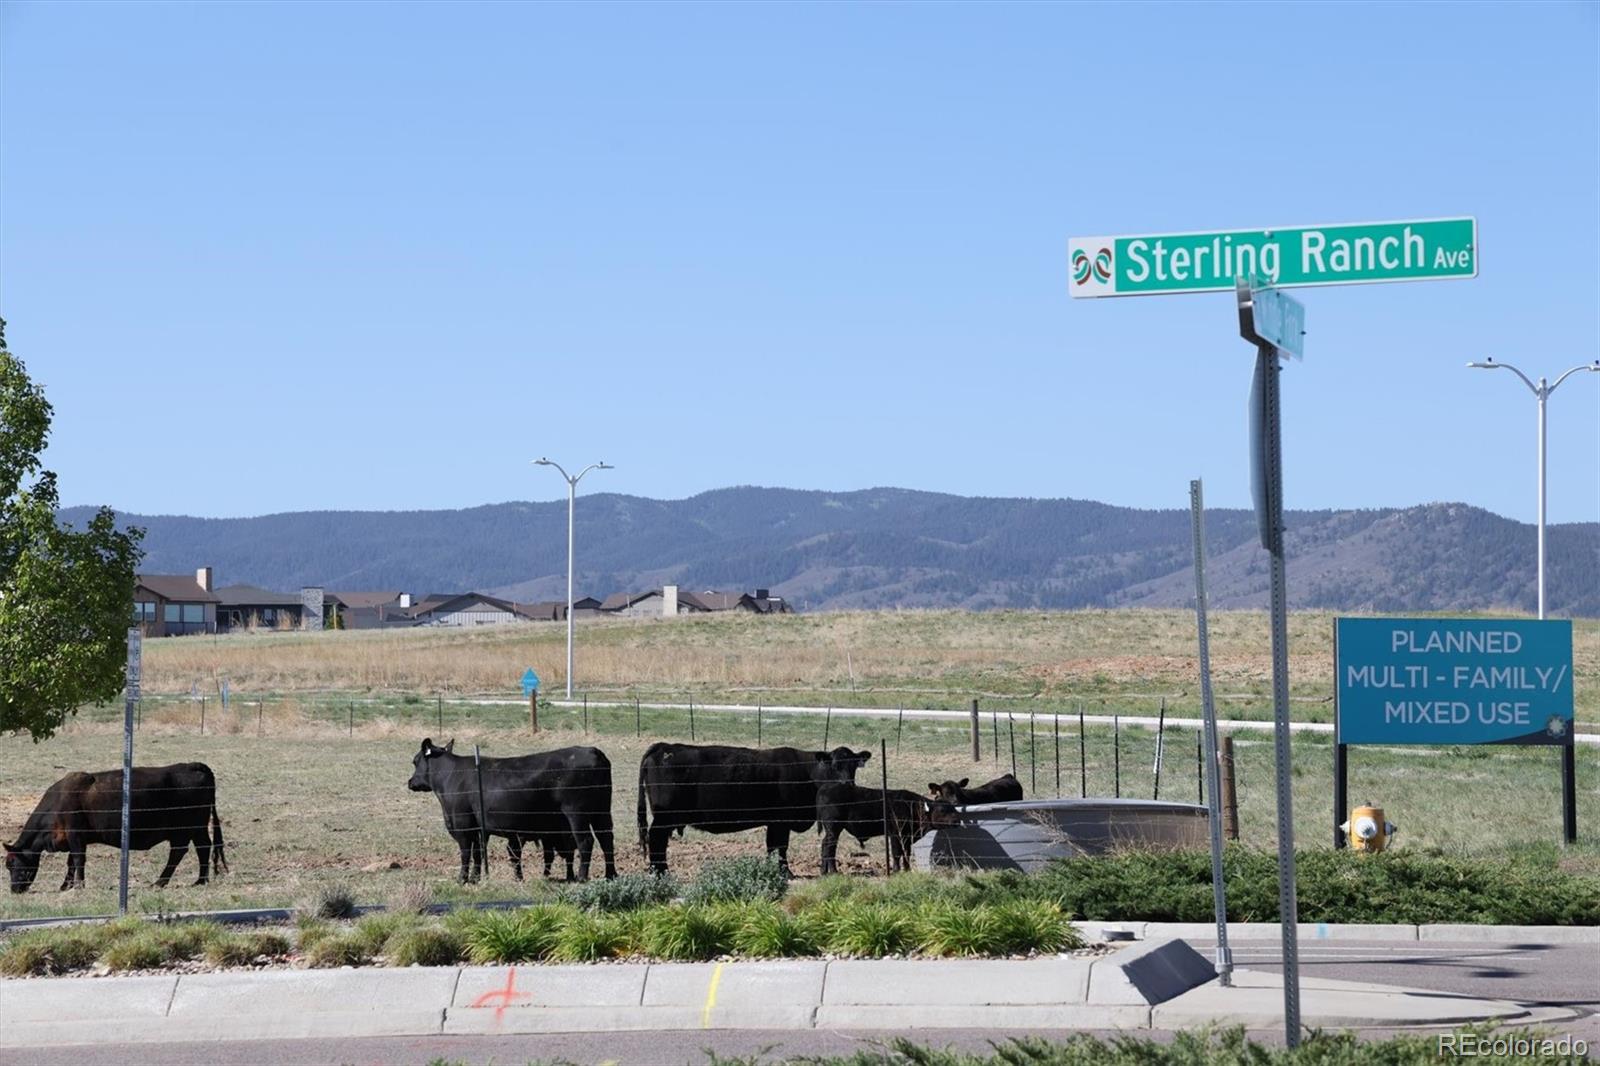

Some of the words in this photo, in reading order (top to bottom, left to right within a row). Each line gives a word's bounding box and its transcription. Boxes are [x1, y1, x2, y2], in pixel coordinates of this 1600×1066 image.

[1126, 236, 1280, 283] Sterling
[1302, 226, 1425, 274] Ranch
[1433, 246, 1470, 269] Ave
[1392, 630, 1522, 654] PLANNED
[1347, 665, 1428, 688] MULTI
[1453, 664, 1567, 693] FAMILY/
[1385, 701, 1470, 724] MIXED
[1478, 702, 1530, 725] USE
